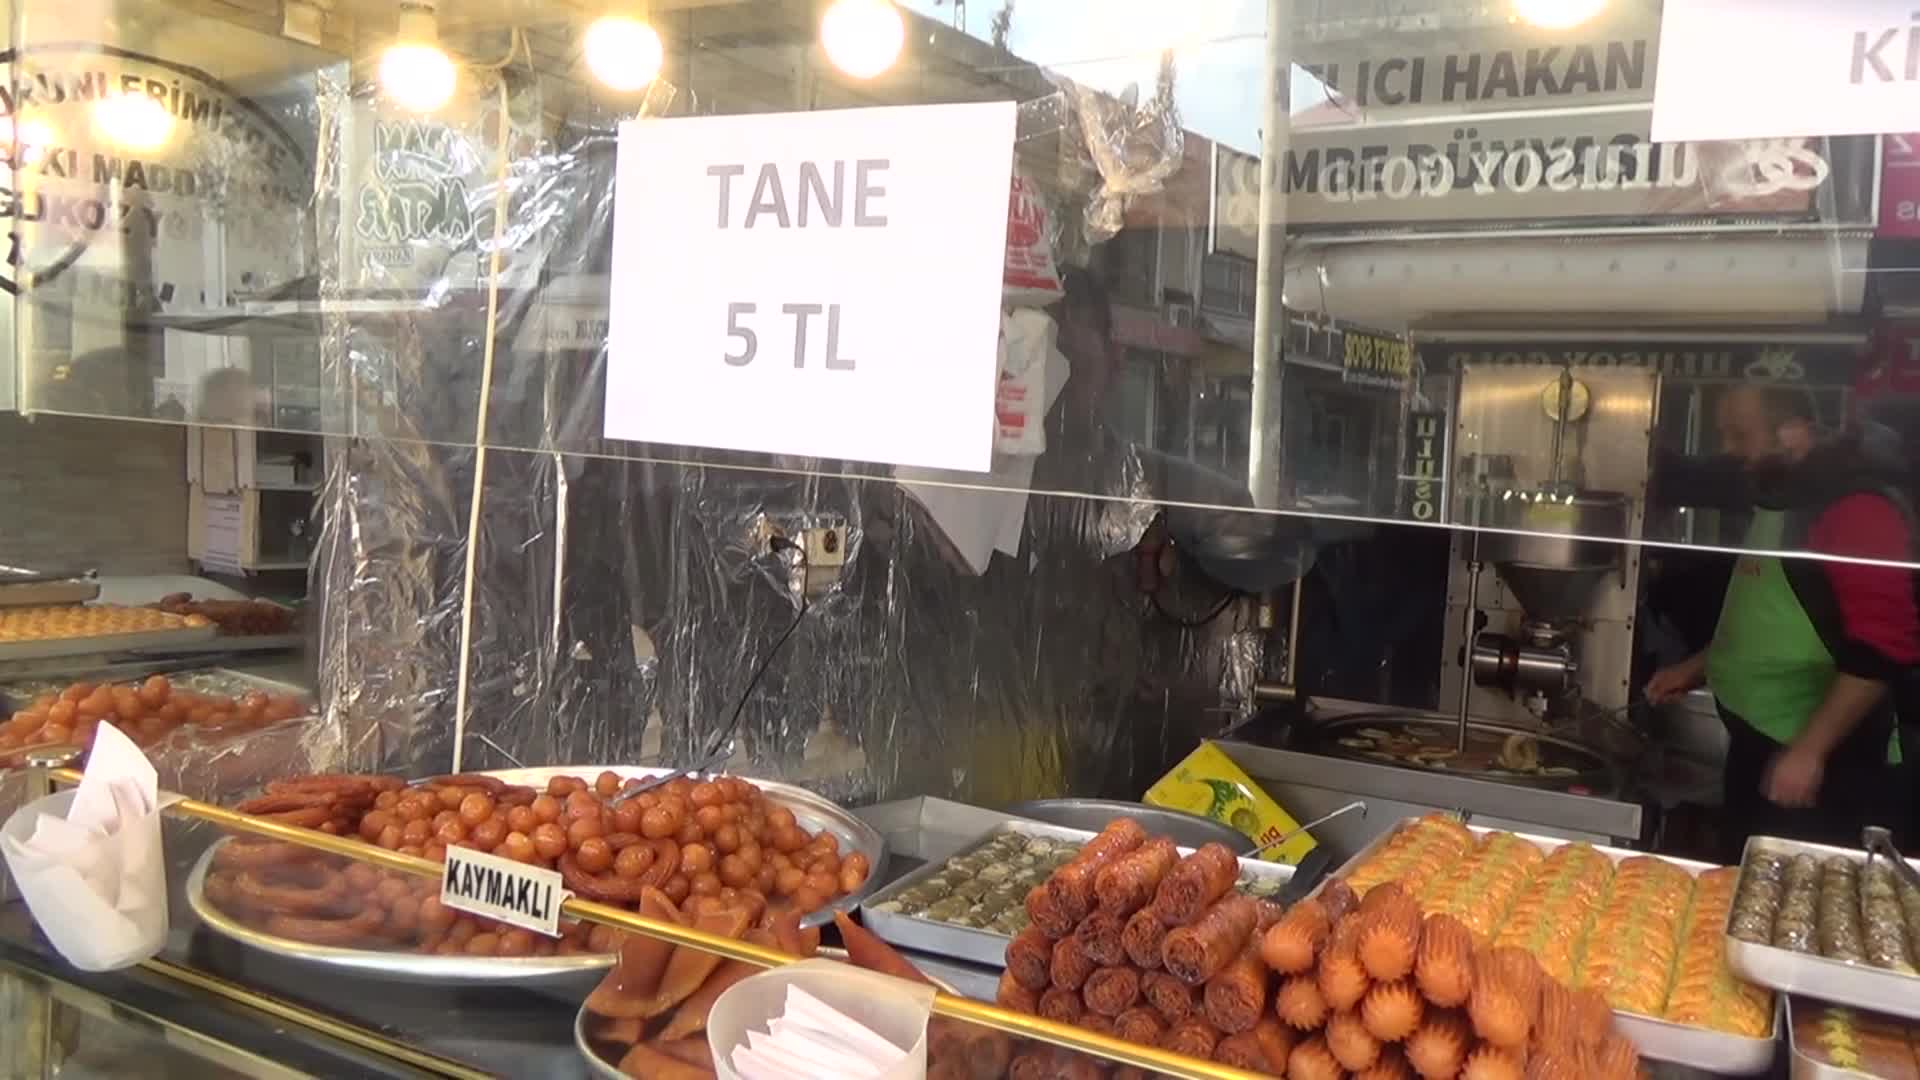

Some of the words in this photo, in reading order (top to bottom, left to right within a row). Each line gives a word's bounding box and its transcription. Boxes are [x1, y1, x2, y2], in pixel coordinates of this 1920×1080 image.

[1442, 40, 1647, 102] HAKAN
[706, 158, 890, 230] TANE
[723, 301, 758, 367] 5
[781, 302, 857, 371] TL
[446, 857, 551, 921] KAYMAKLI
